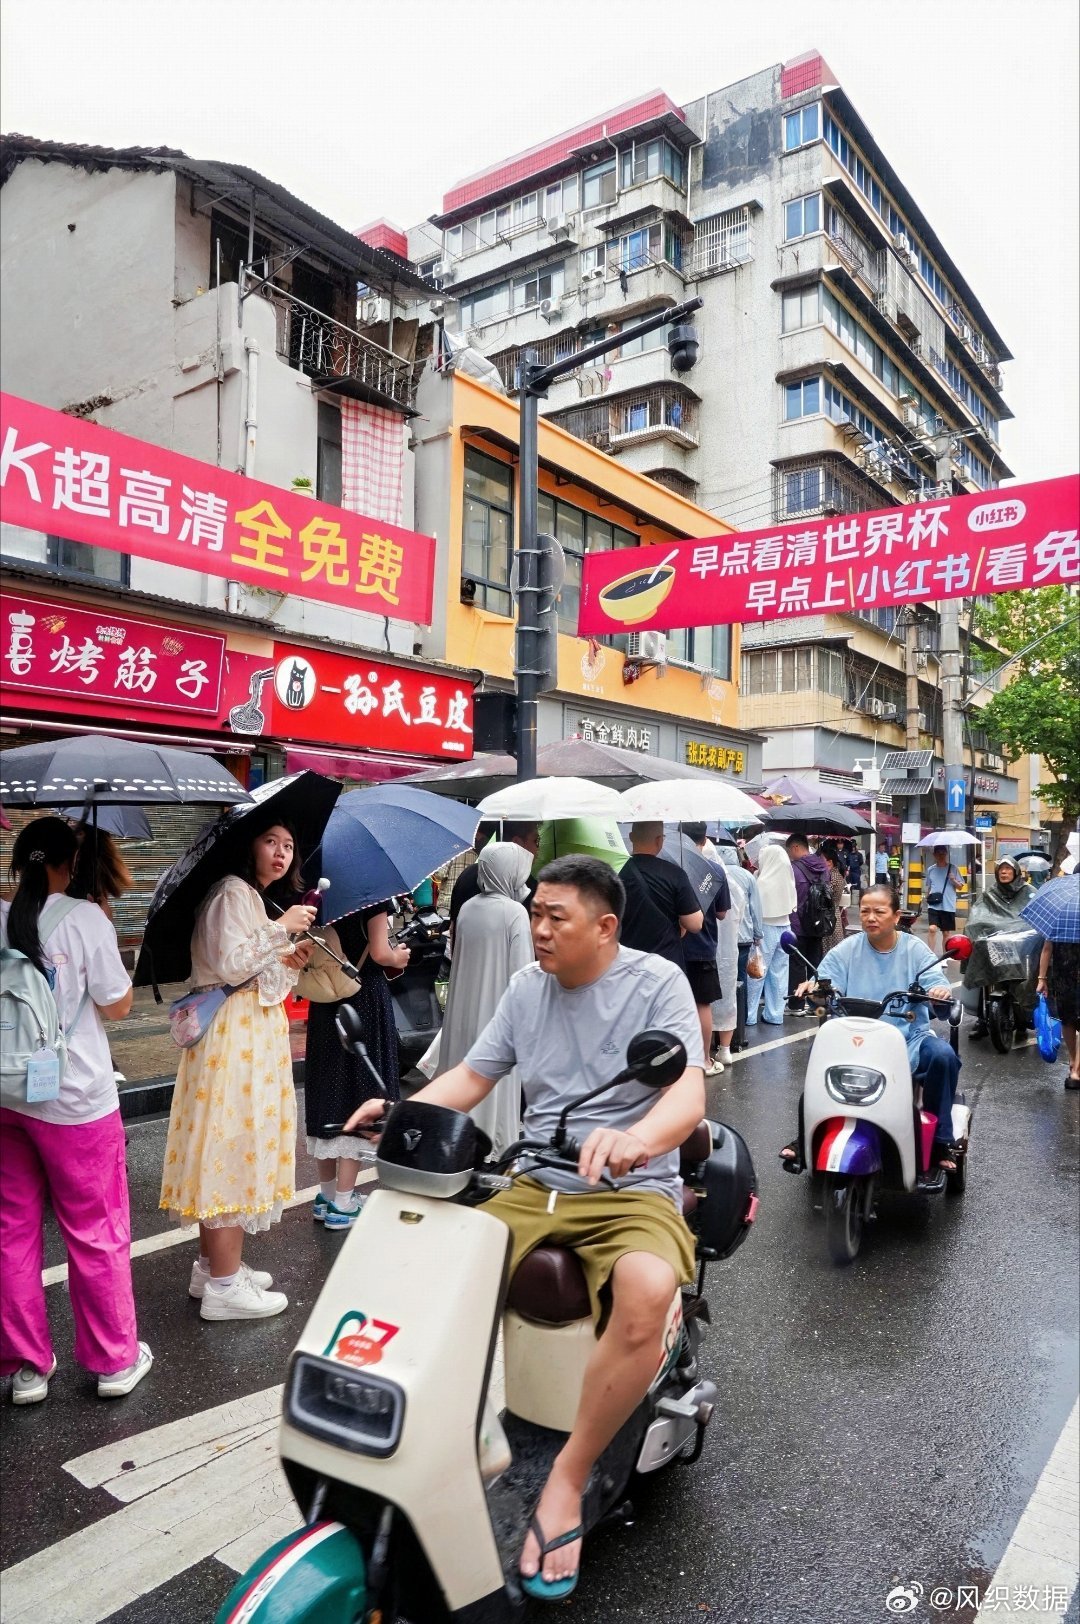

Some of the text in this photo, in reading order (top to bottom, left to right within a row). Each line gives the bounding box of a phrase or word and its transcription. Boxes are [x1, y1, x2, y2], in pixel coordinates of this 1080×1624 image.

[0, 426, 404, 606] K超高清全免费
[975, 505, 1019, 526] 小红书
[689, 505, 951, 580] 早点看清世界杯
[581, 717, 652, 750] 高金鲜肉店
[687, 740, 744, 773] 张氏农副产品
